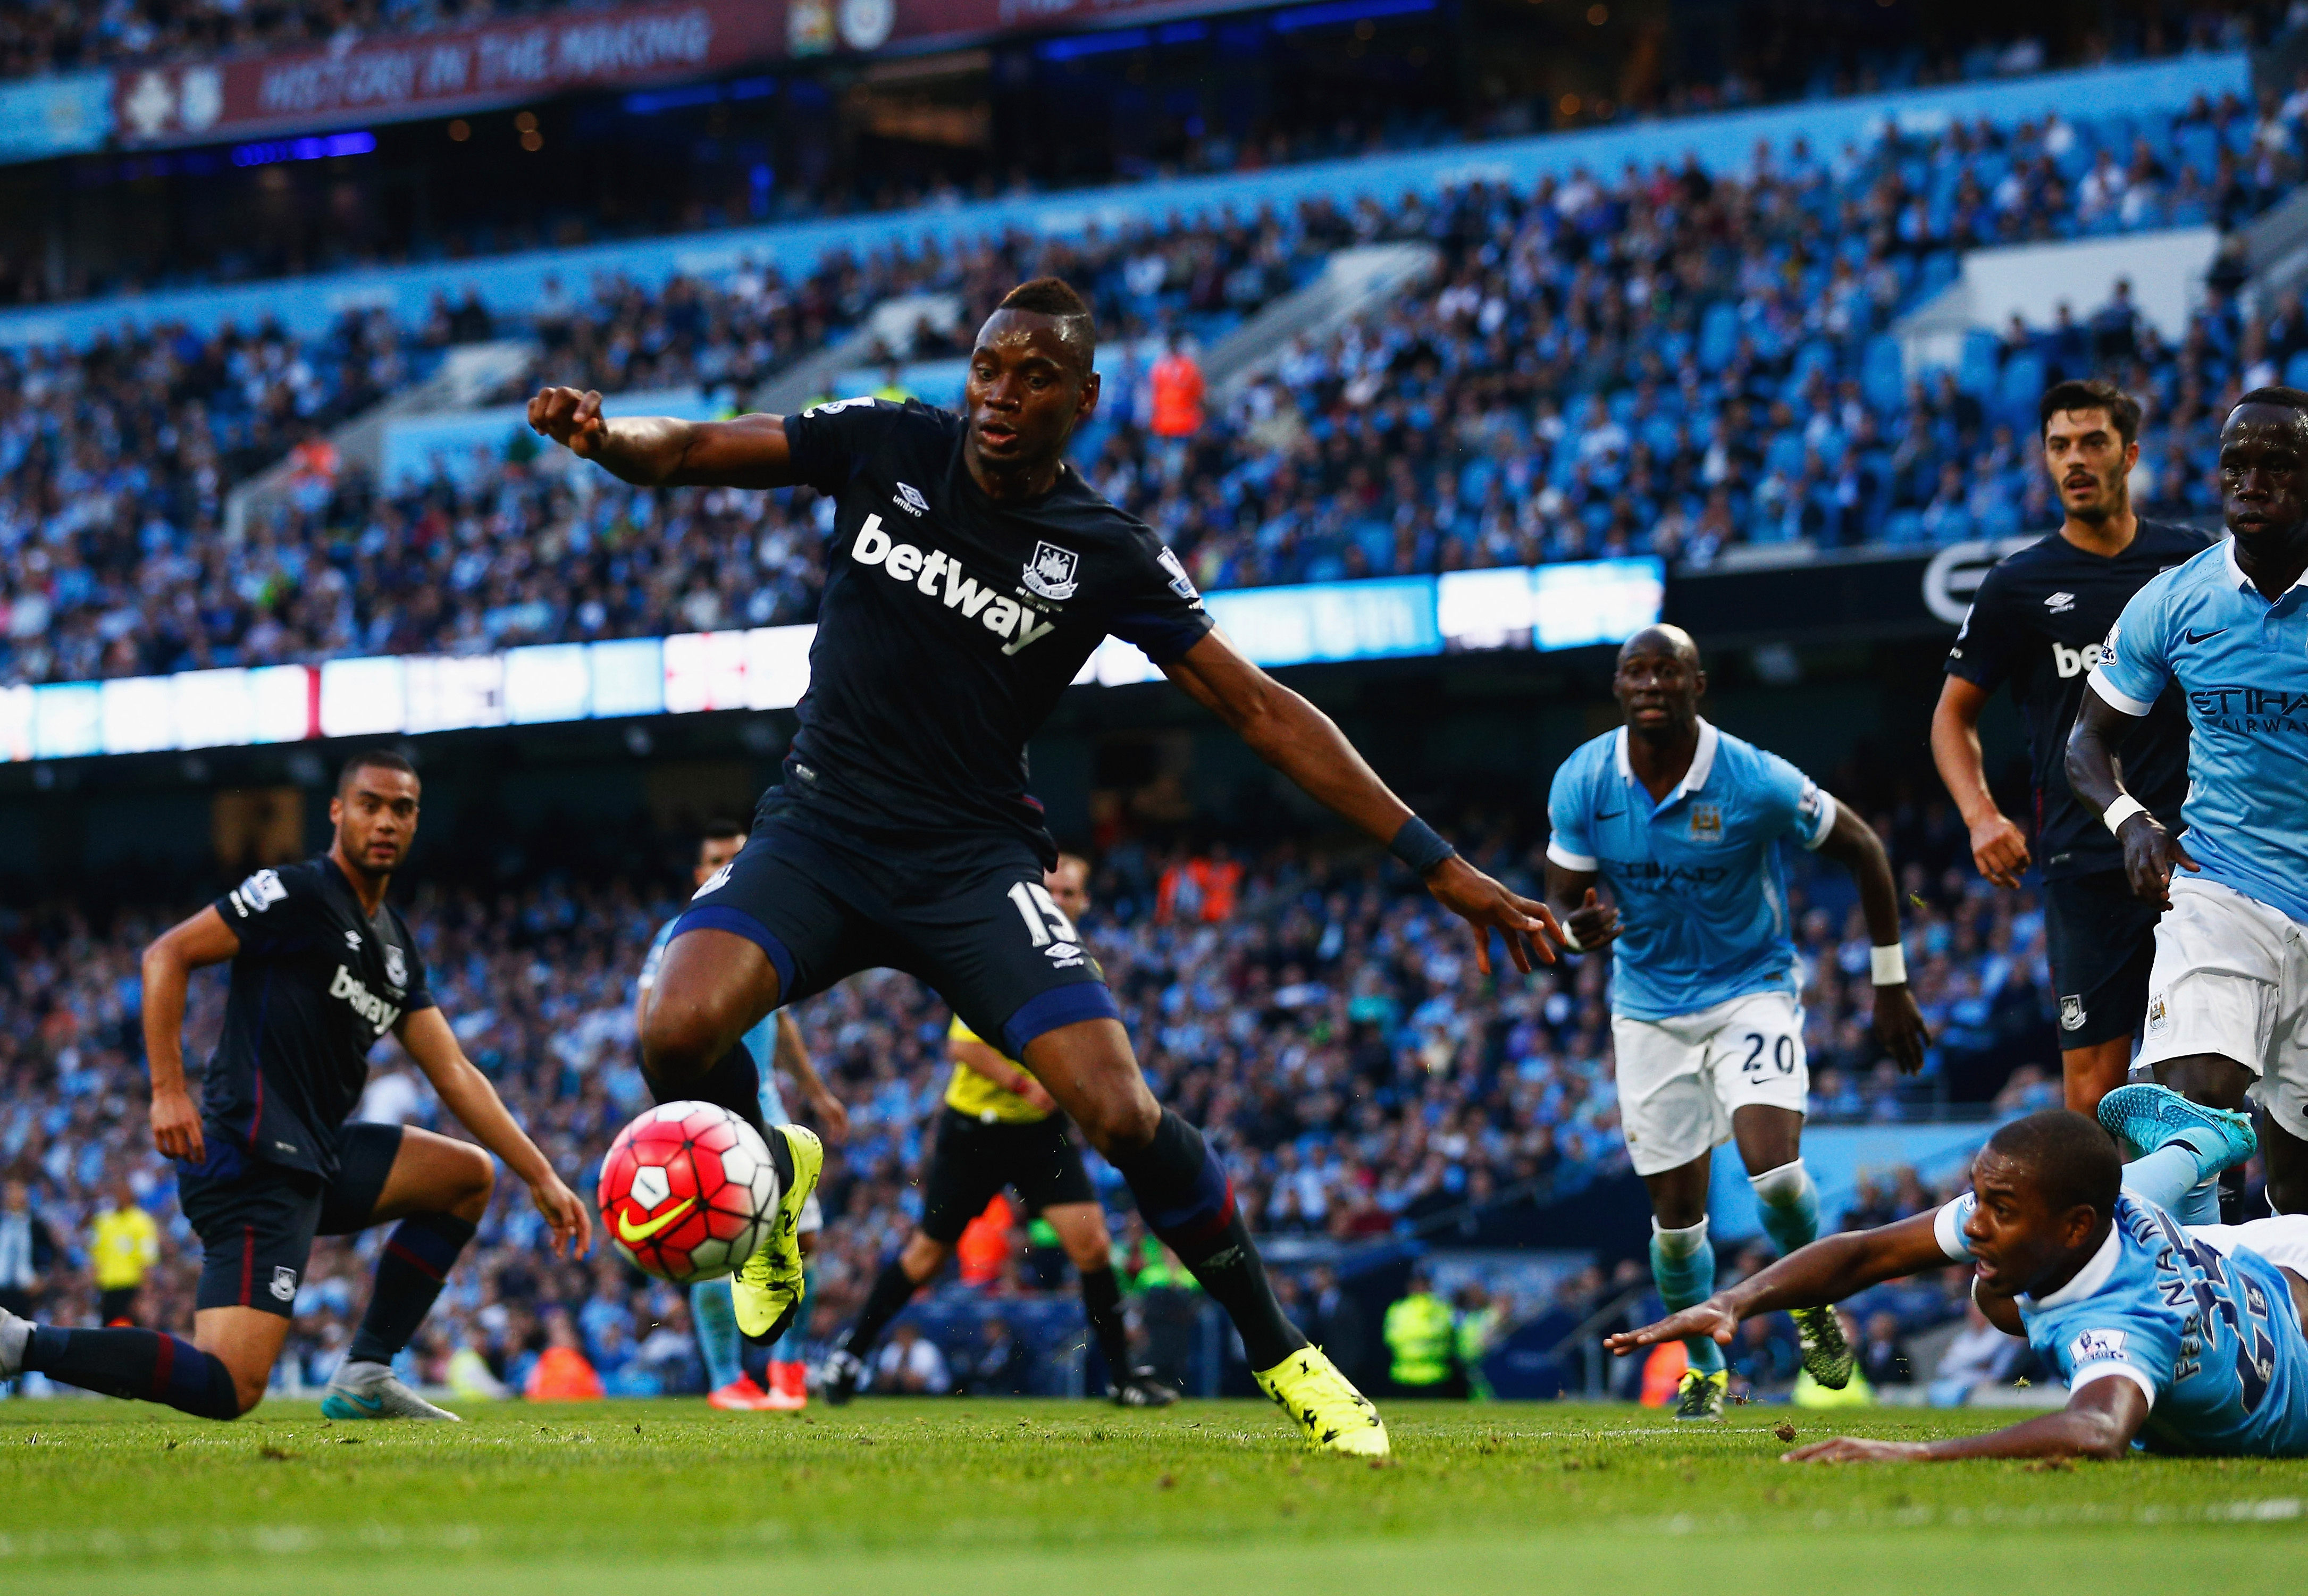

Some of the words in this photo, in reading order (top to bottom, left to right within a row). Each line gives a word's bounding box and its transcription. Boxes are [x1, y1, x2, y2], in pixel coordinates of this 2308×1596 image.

[893, 494, 922, 518] umbro
[851, 513, 1055, 656] betway
[1006, 880, 1077, 948] 15
[1742, 1032, 1795, 1074] 20
